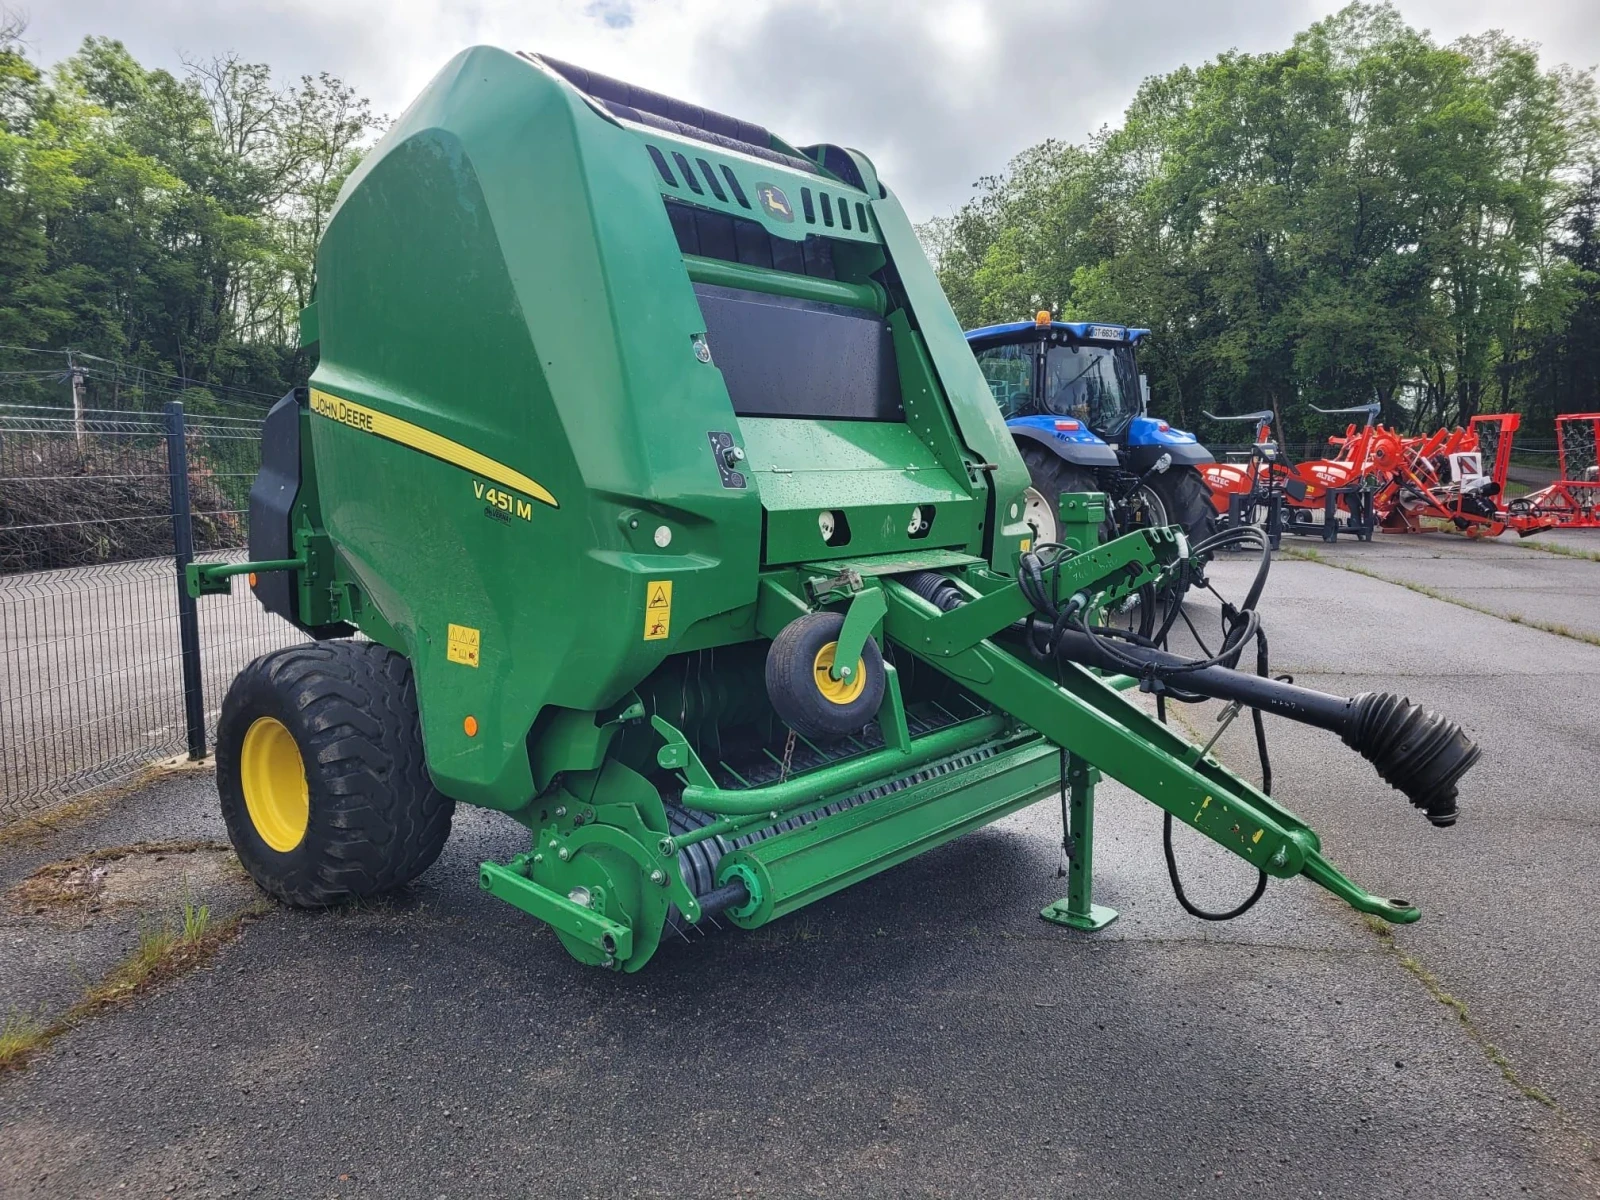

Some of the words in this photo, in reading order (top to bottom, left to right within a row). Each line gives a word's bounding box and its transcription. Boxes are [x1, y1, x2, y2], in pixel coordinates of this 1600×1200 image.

[315, 394, 338, 418] JOHN
[339, 402, 373, 431] DEERE
[1208, 474, 1230, 487] ALTEC
[1316, 472, 1337, 483] ALTEC
[473, 480, 485, 499] V
[485, 488, 513, 513] 451
[516, 498, 532, 521] M
